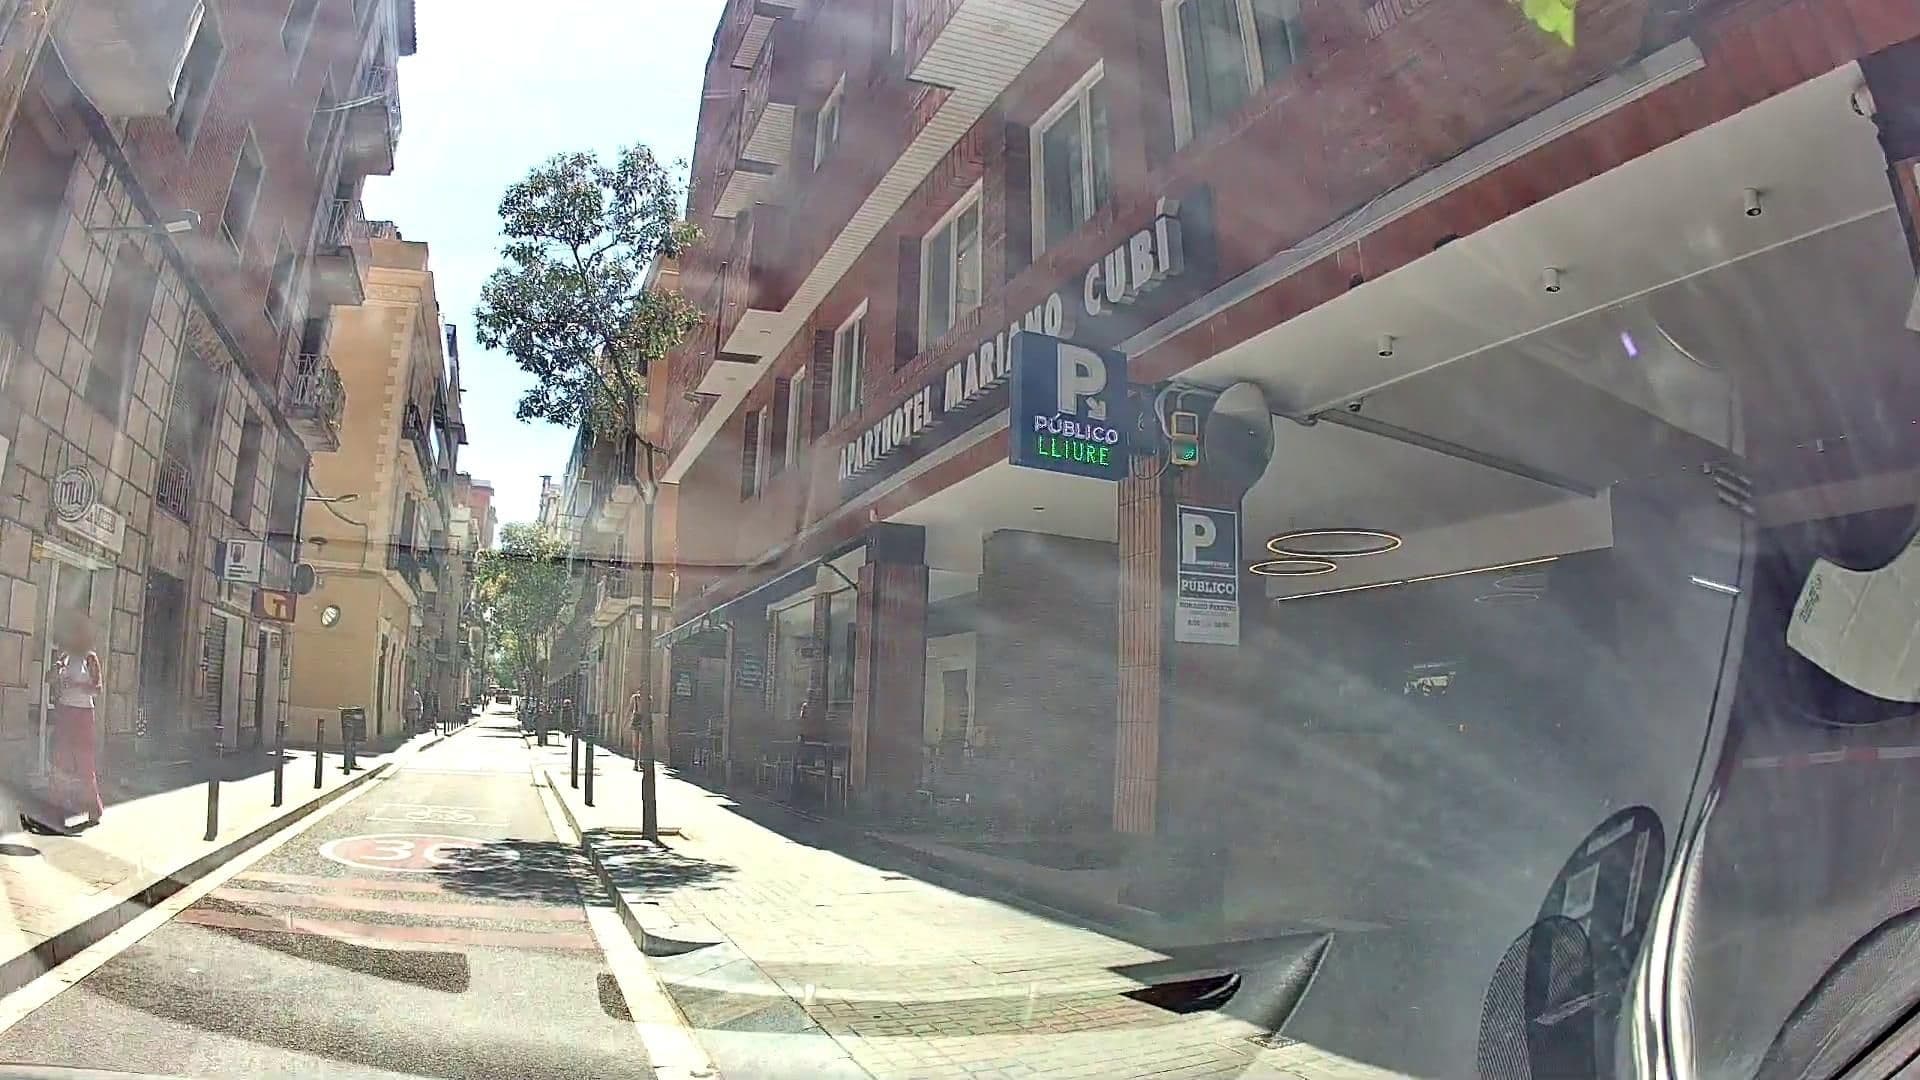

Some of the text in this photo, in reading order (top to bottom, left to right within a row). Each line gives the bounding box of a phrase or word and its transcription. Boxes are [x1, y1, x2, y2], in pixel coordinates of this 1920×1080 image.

[838, 385, 933, 482] APARTHOTEL
[1084, 196, 1173, 316] CUBÍ
[1057, 343, 1107, 415] P
[1034, 413, 1119, 445] PÚBLICO
[1039, 436, 1110, 466] LLIURE
[1182, 513, 1217, 564] P
